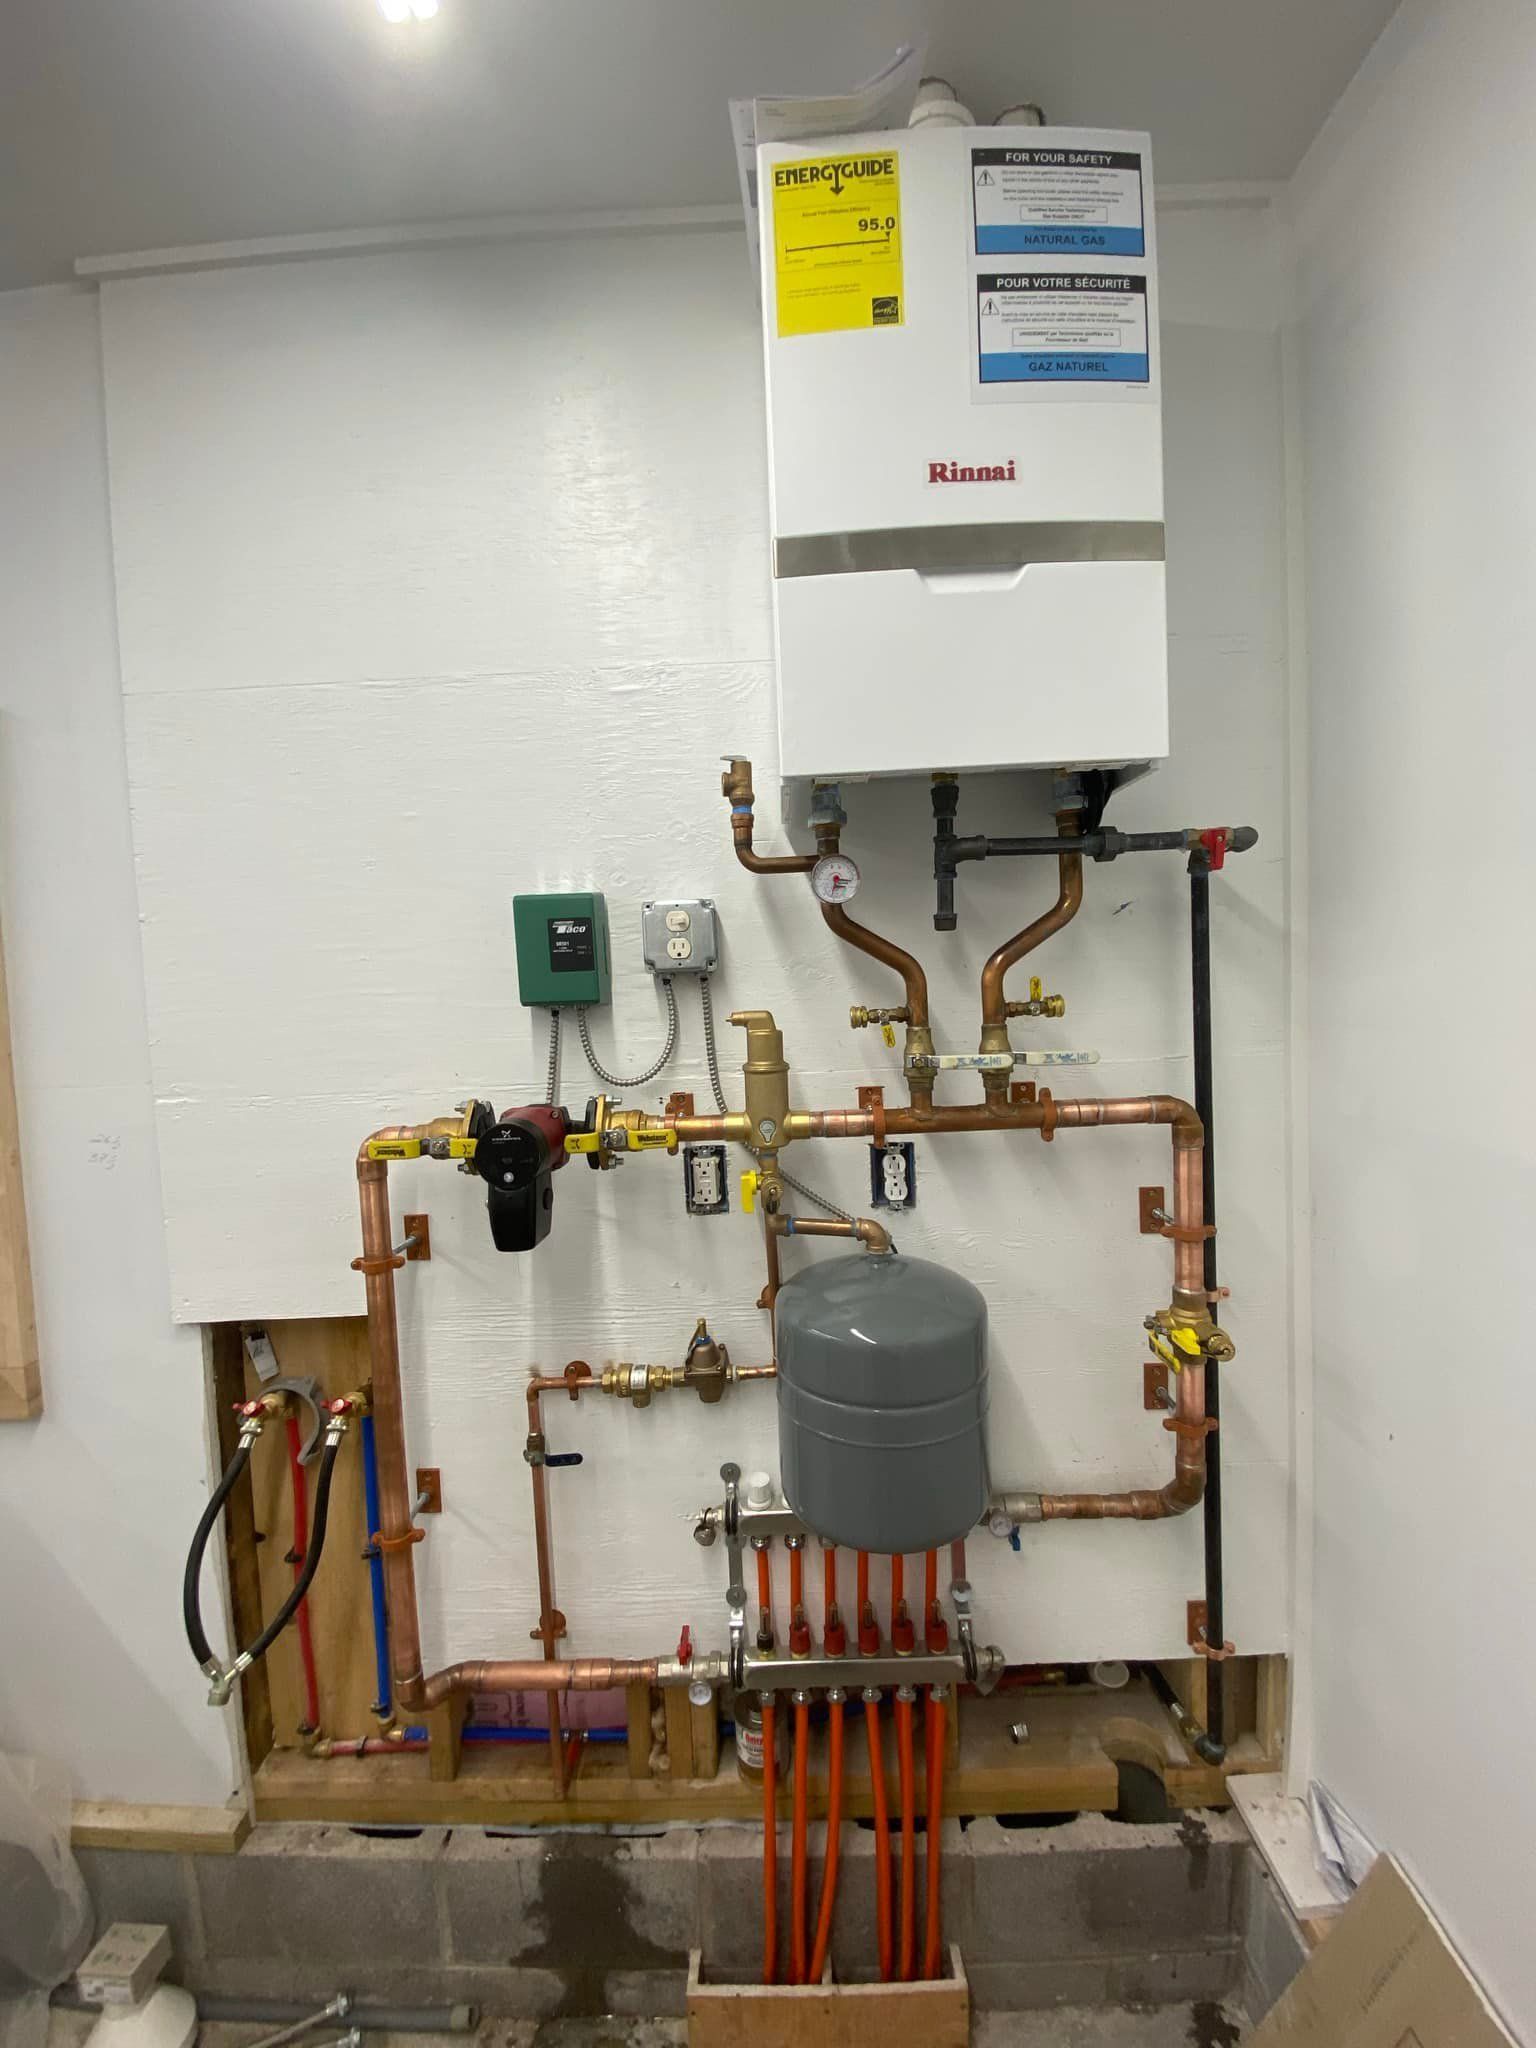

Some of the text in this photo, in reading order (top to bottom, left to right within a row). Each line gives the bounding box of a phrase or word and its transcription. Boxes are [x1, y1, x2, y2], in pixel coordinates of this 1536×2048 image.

[1005, 152, 1113, 165] FOR YOUR SAFETY
[775, 159, 894, 187] ENERGYGUIDE
[858, 217, 896, 231] 95.0
[1024, 235, 1105, 246] NATURAL GAS
[996, 275, 1131, 289] POUR VOTRE SÉCURITÉ
[1028, 361, 1109, 372] GAZ NATUREL
[928, 460, 1016, 483] Rinnai
